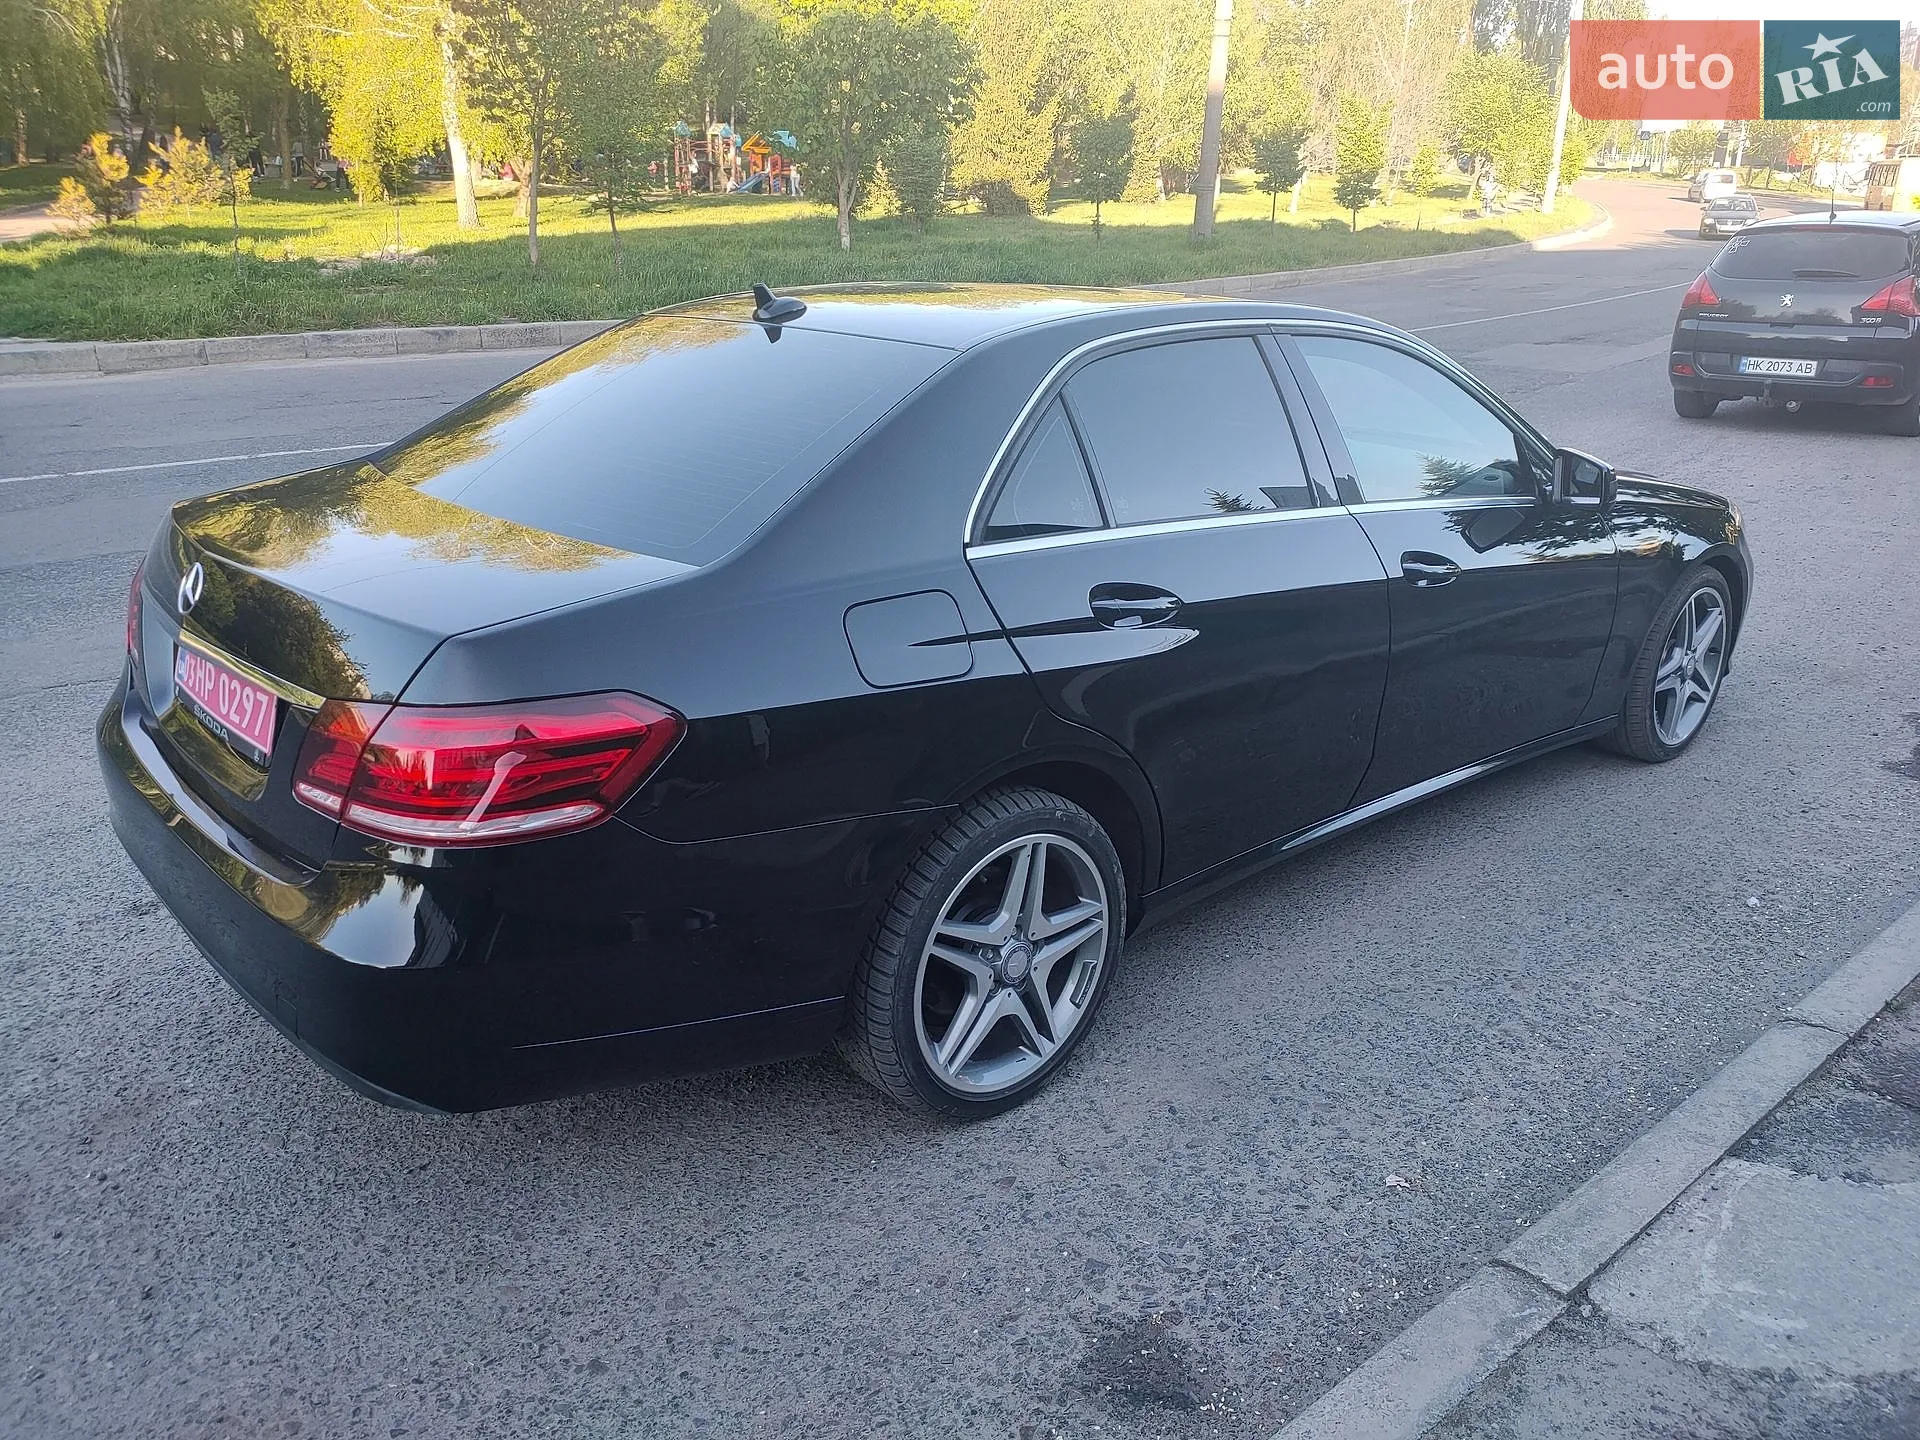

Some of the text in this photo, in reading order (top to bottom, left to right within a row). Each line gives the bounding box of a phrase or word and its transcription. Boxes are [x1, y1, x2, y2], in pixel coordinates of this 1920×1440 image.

[1747, 360, 1764, 371] HK
[1766, 360, 1793, 373] 2073
[1795, 363, 1814, 374] AB
[219, 673, 270, 737] 0297
